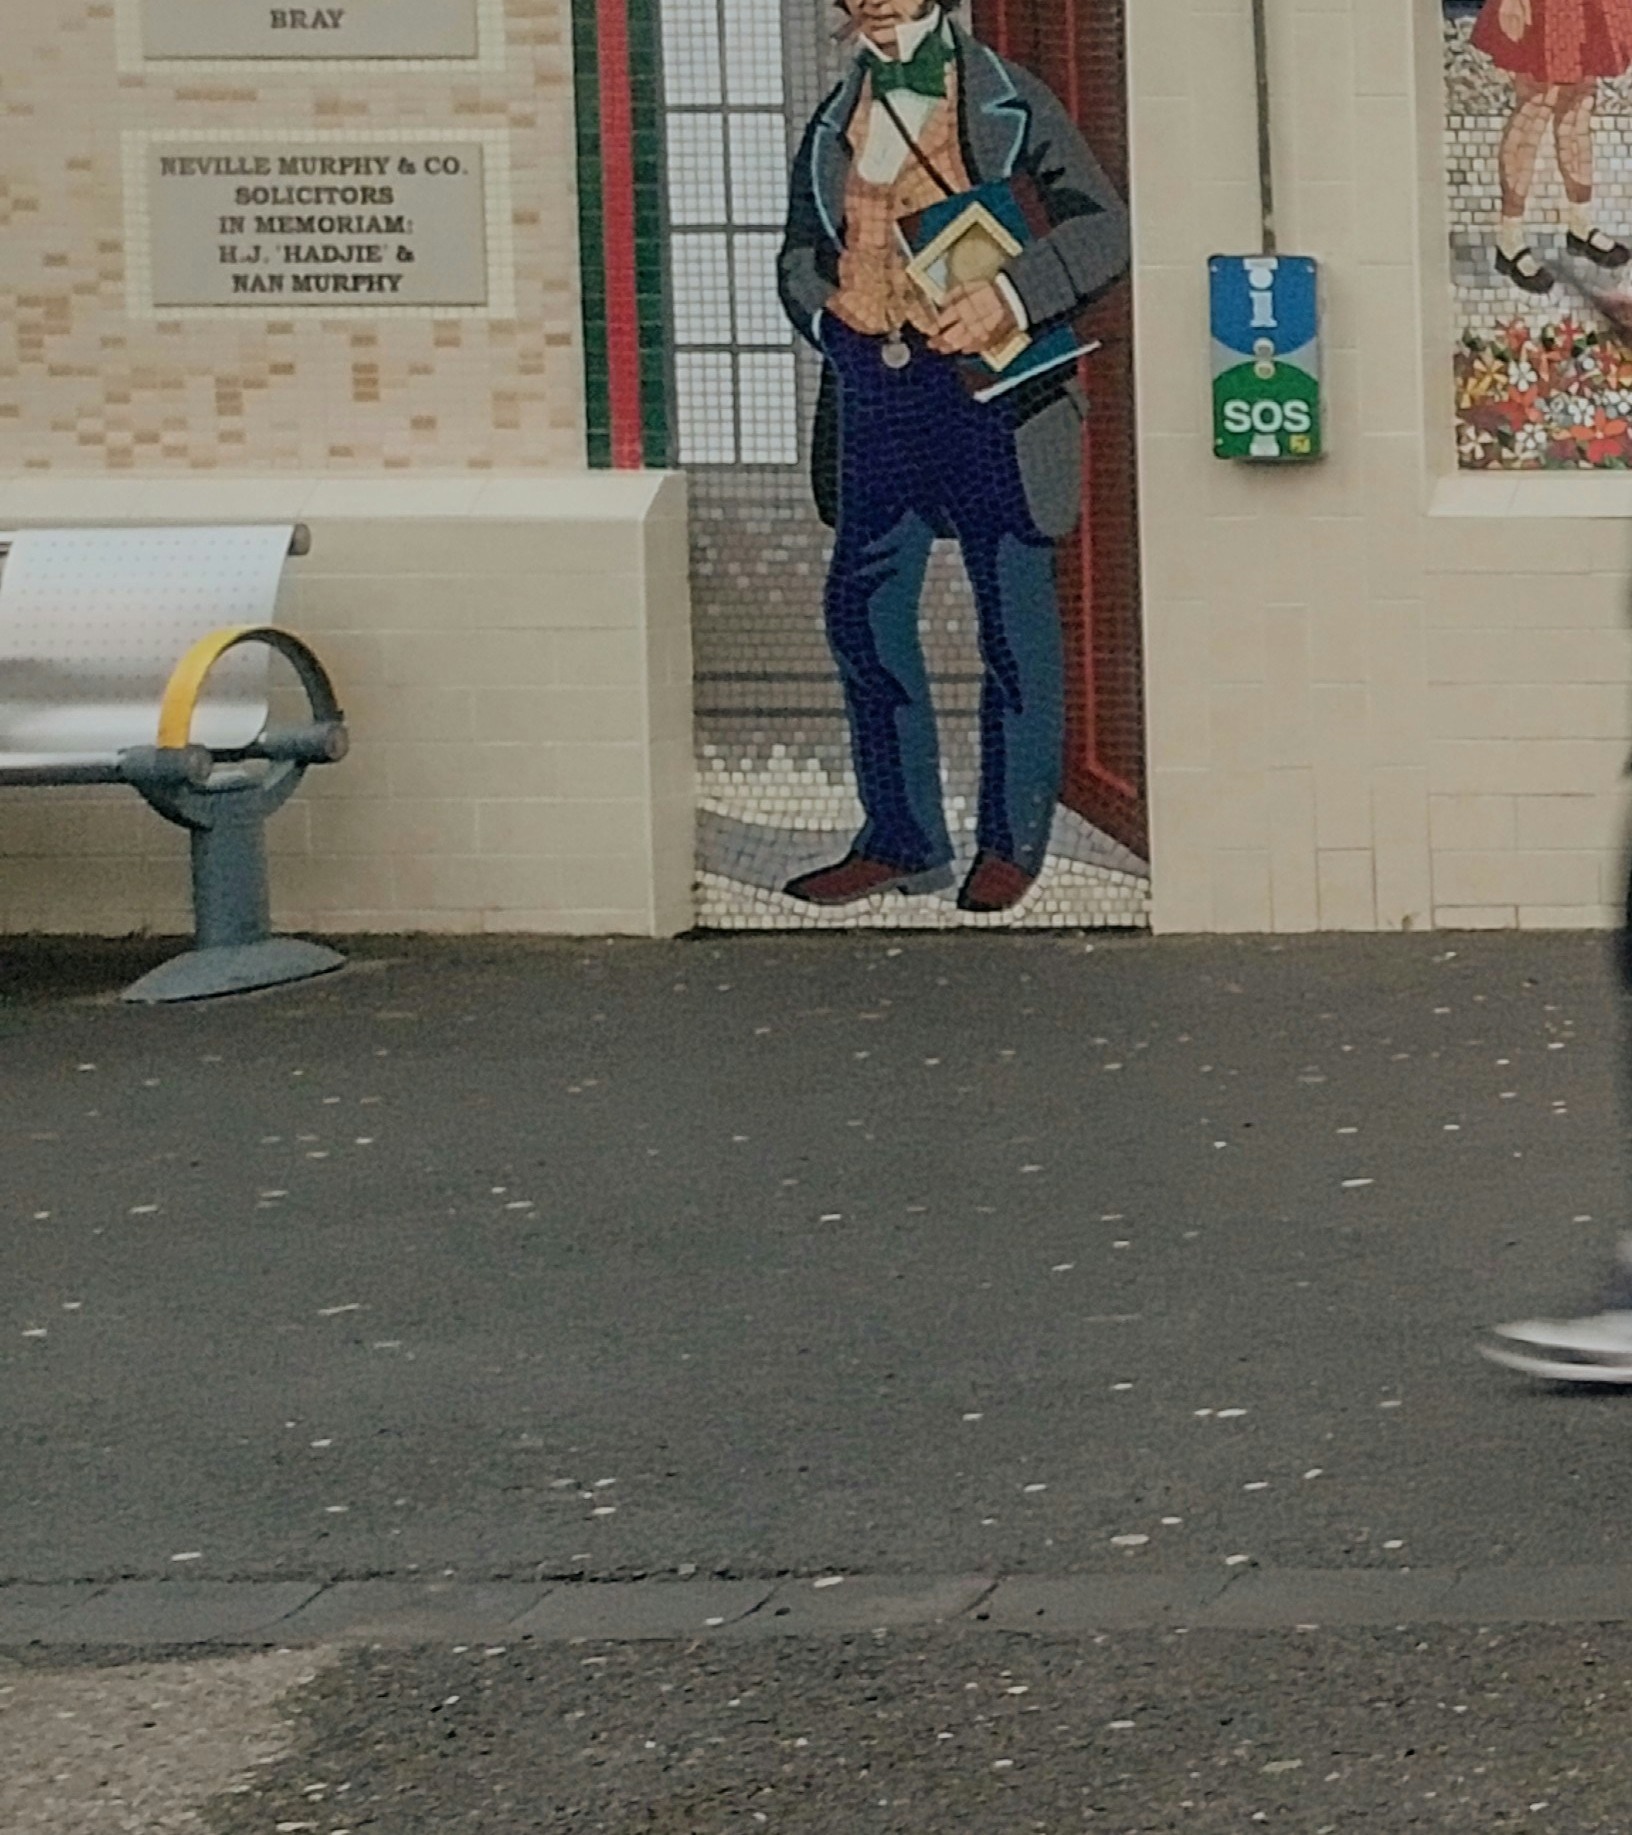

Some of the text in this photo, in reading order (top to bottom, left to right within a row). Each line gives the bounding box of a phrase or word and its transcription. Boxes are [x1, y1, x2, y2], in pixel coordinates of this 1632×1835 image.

[270, 9, 344, 29] BRAY
[160, 156, 469, 176] NEVILLE MURPHY & CO.
[235, 186, 395, 205] SOLICITORS
[218, 215, 414, 235] IN MEMORIAM:
[396, 245, 415, 264] &
[232, 274, 404, 294] NAN MURPHY
[1223, 398, 1311, 433] SOS
